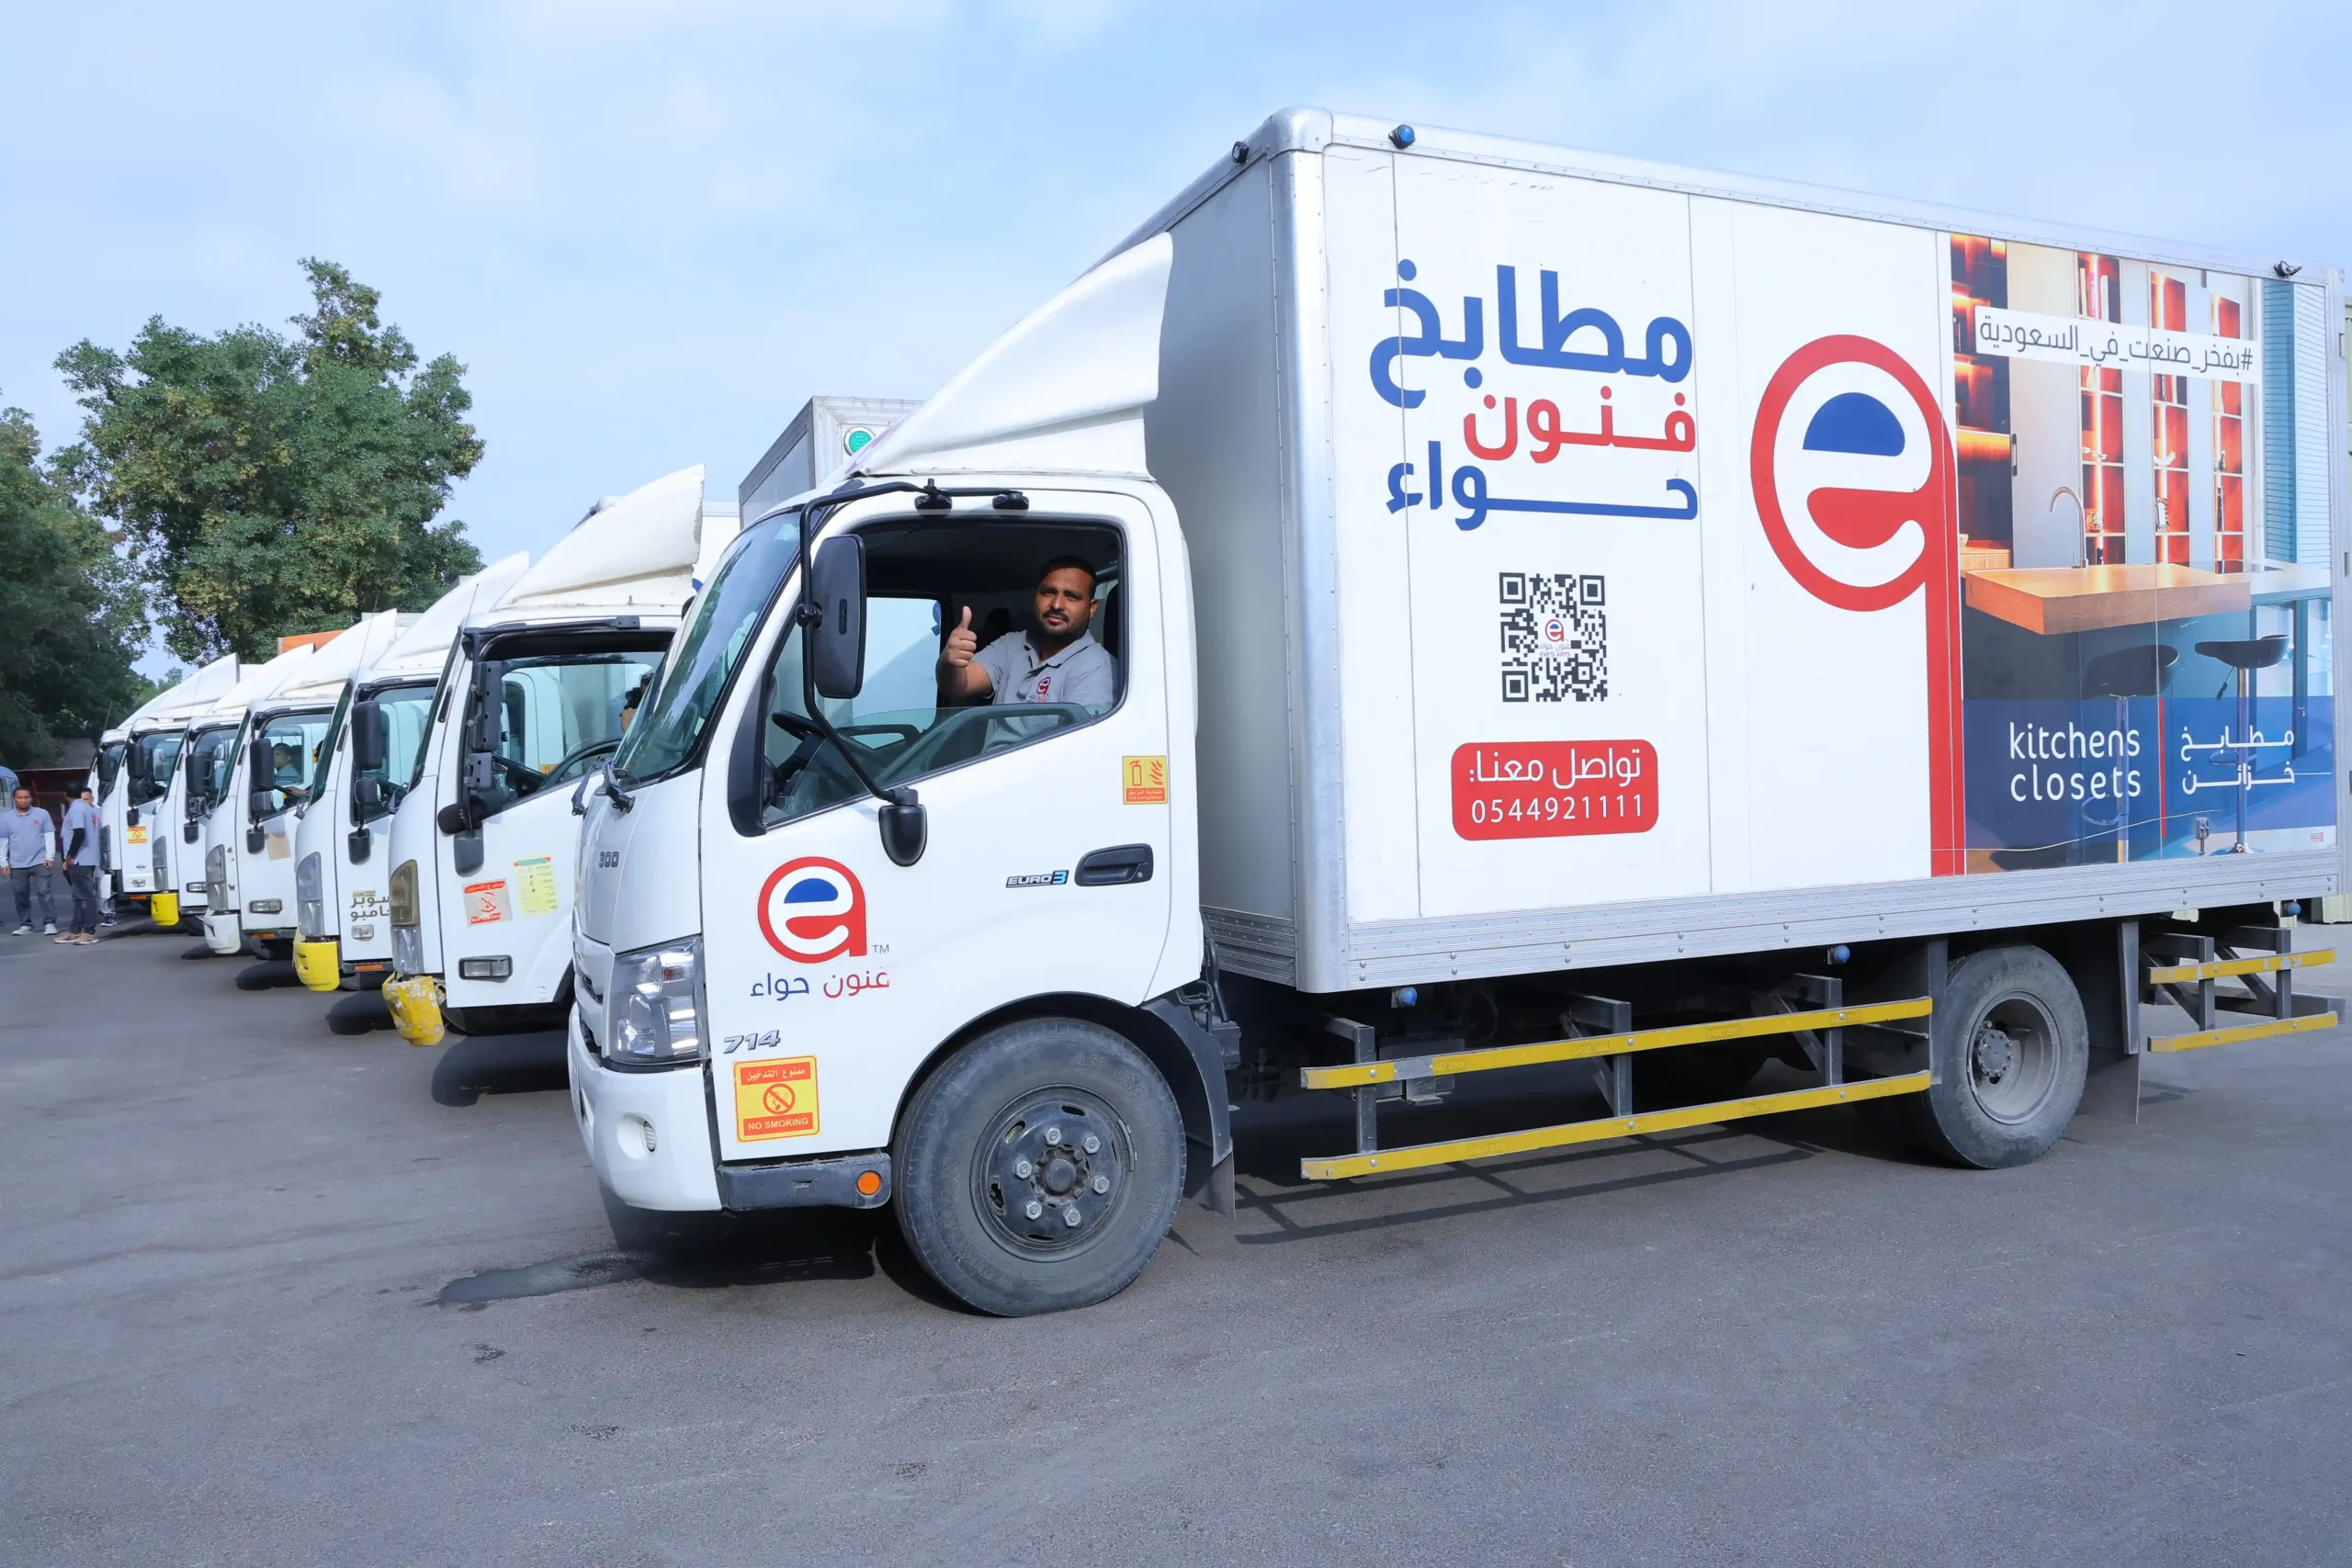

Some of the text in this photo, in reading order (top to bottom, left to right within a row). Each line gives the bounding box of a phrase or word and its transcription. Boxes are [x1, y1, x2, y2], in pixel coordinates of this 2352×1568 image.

[1370, 259, 1692, 409] مطابخ
[1464, 385, 1695, 463] فنون
[1385, 440, 1698, 531] حواء
[2009, 721, 2140, 760] kitchens
[2180, 725, 2294, 761] مطابخ
[1469, 748, 1641, 789] تواصل معنا:
[2010, 763, 2141, 802] closets
[2182, 761, 2295, 795] خزائن
[1471, 794, 1641, 824] 0544921111
[599, 851, 619, 868] 300
[872, 944, 889, 954] TM
[751, 973, 809, 1001] حواء
[723, 1030, 781, 1055] 714
[748, 1117, 808, 1130] NO SMOKING
